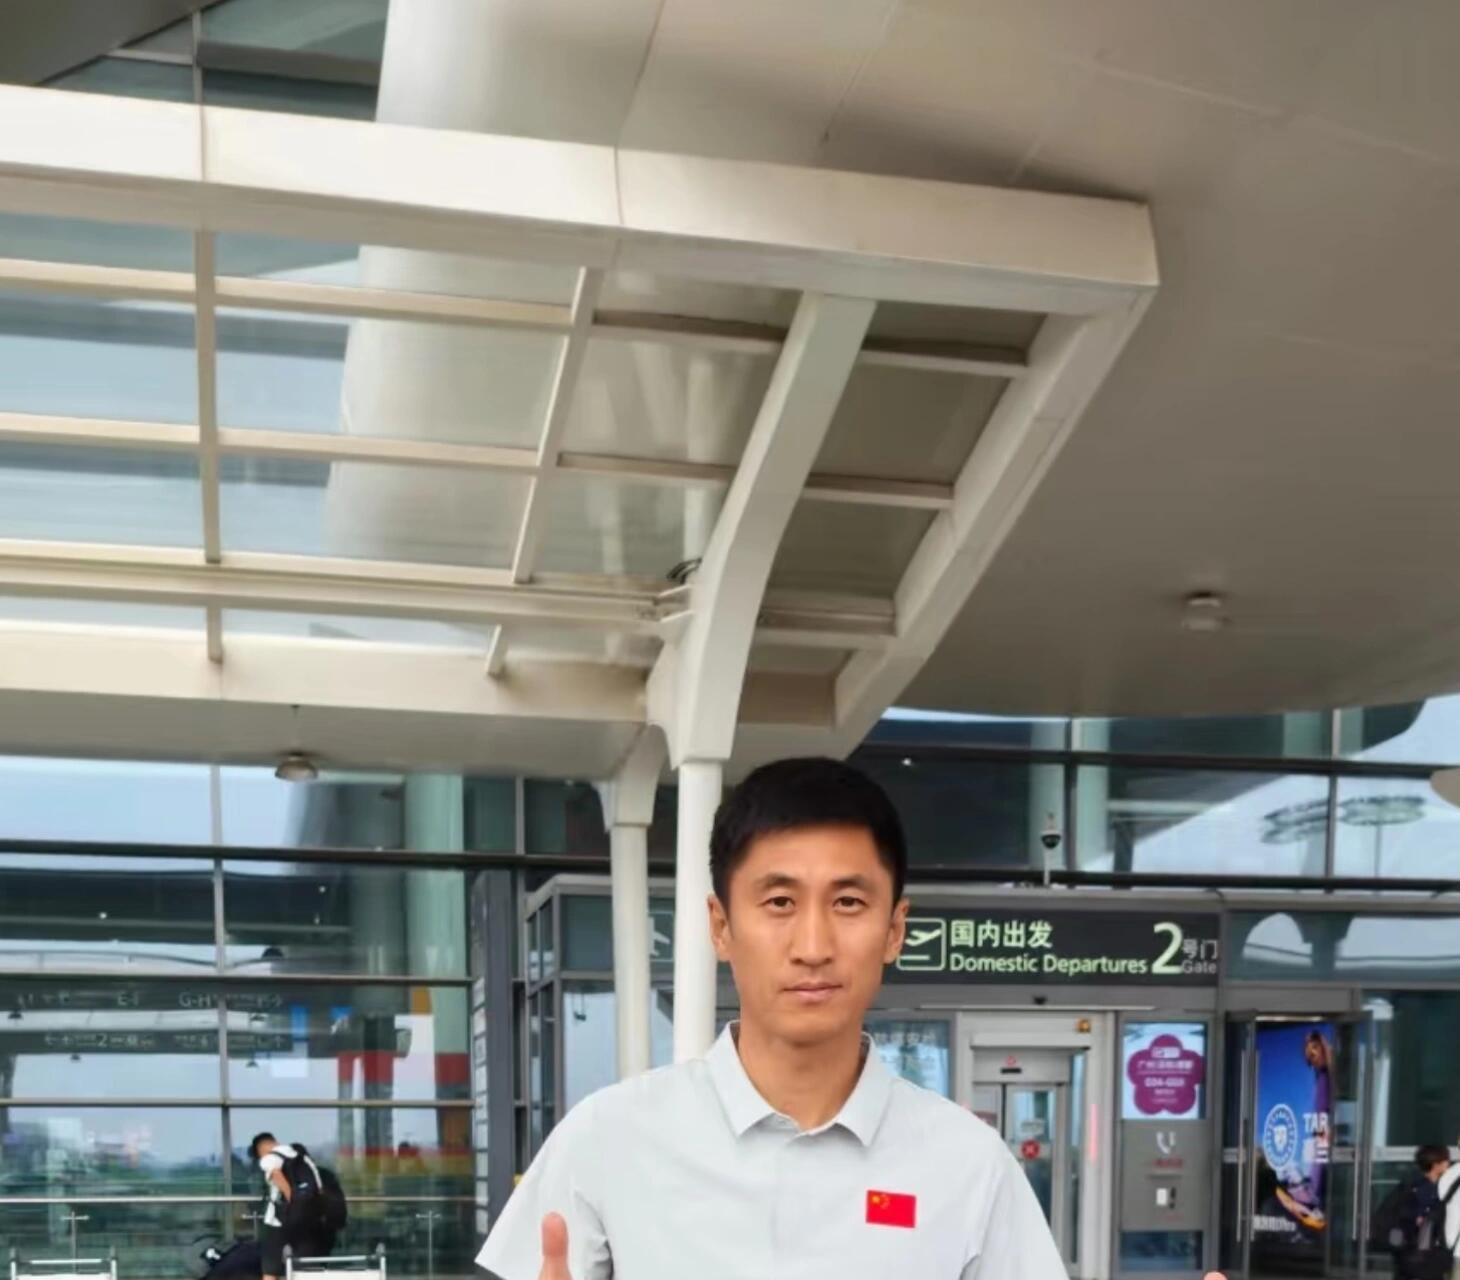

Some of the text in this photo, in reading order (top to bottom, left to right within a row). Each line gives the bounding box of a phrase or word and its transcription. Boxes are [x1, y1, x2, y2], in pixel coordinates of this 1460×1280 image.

[951, 919, 1053, 949] 国内出发
[1151, 922, 1183, 974] 2
[950, 953, 1147, 976] Domestic Departures
[1182, 959, 1217, 974] Gate
